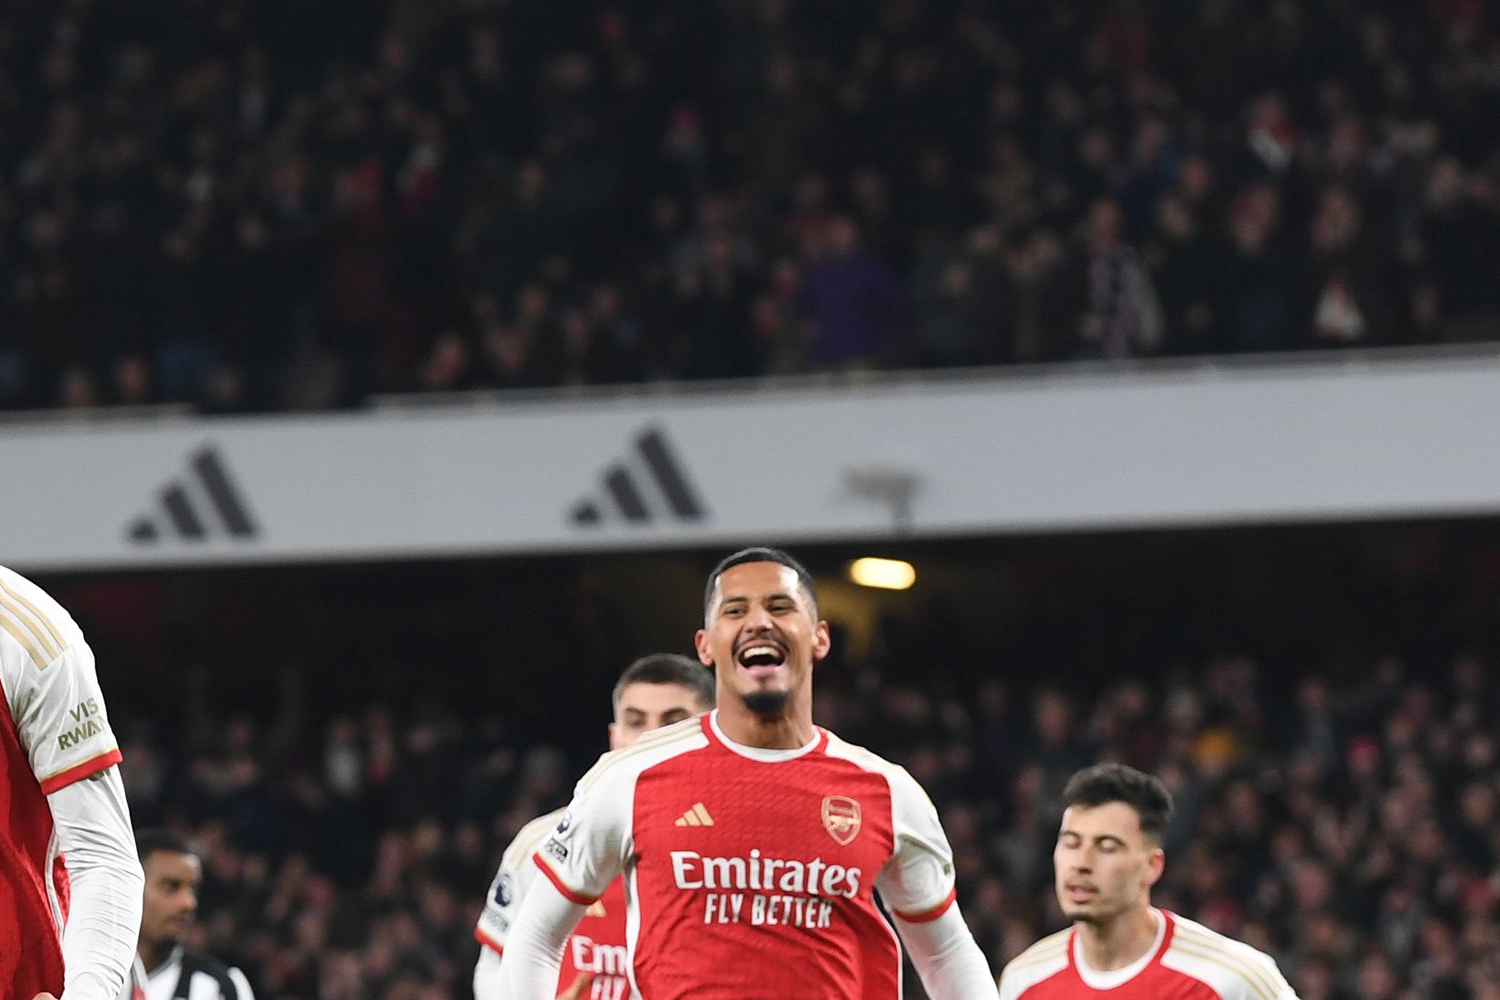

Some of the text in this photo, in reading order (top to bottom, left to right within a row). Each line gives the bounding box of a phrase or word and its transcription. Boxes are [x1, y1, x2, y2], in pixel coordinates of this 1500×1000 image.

[69, 697, 99, 722] VIS
[58, 719, 104, 751] RWA
[670, 848, 862, 899] Emirates
[704, 893, 833, 929] FLY BETTER
